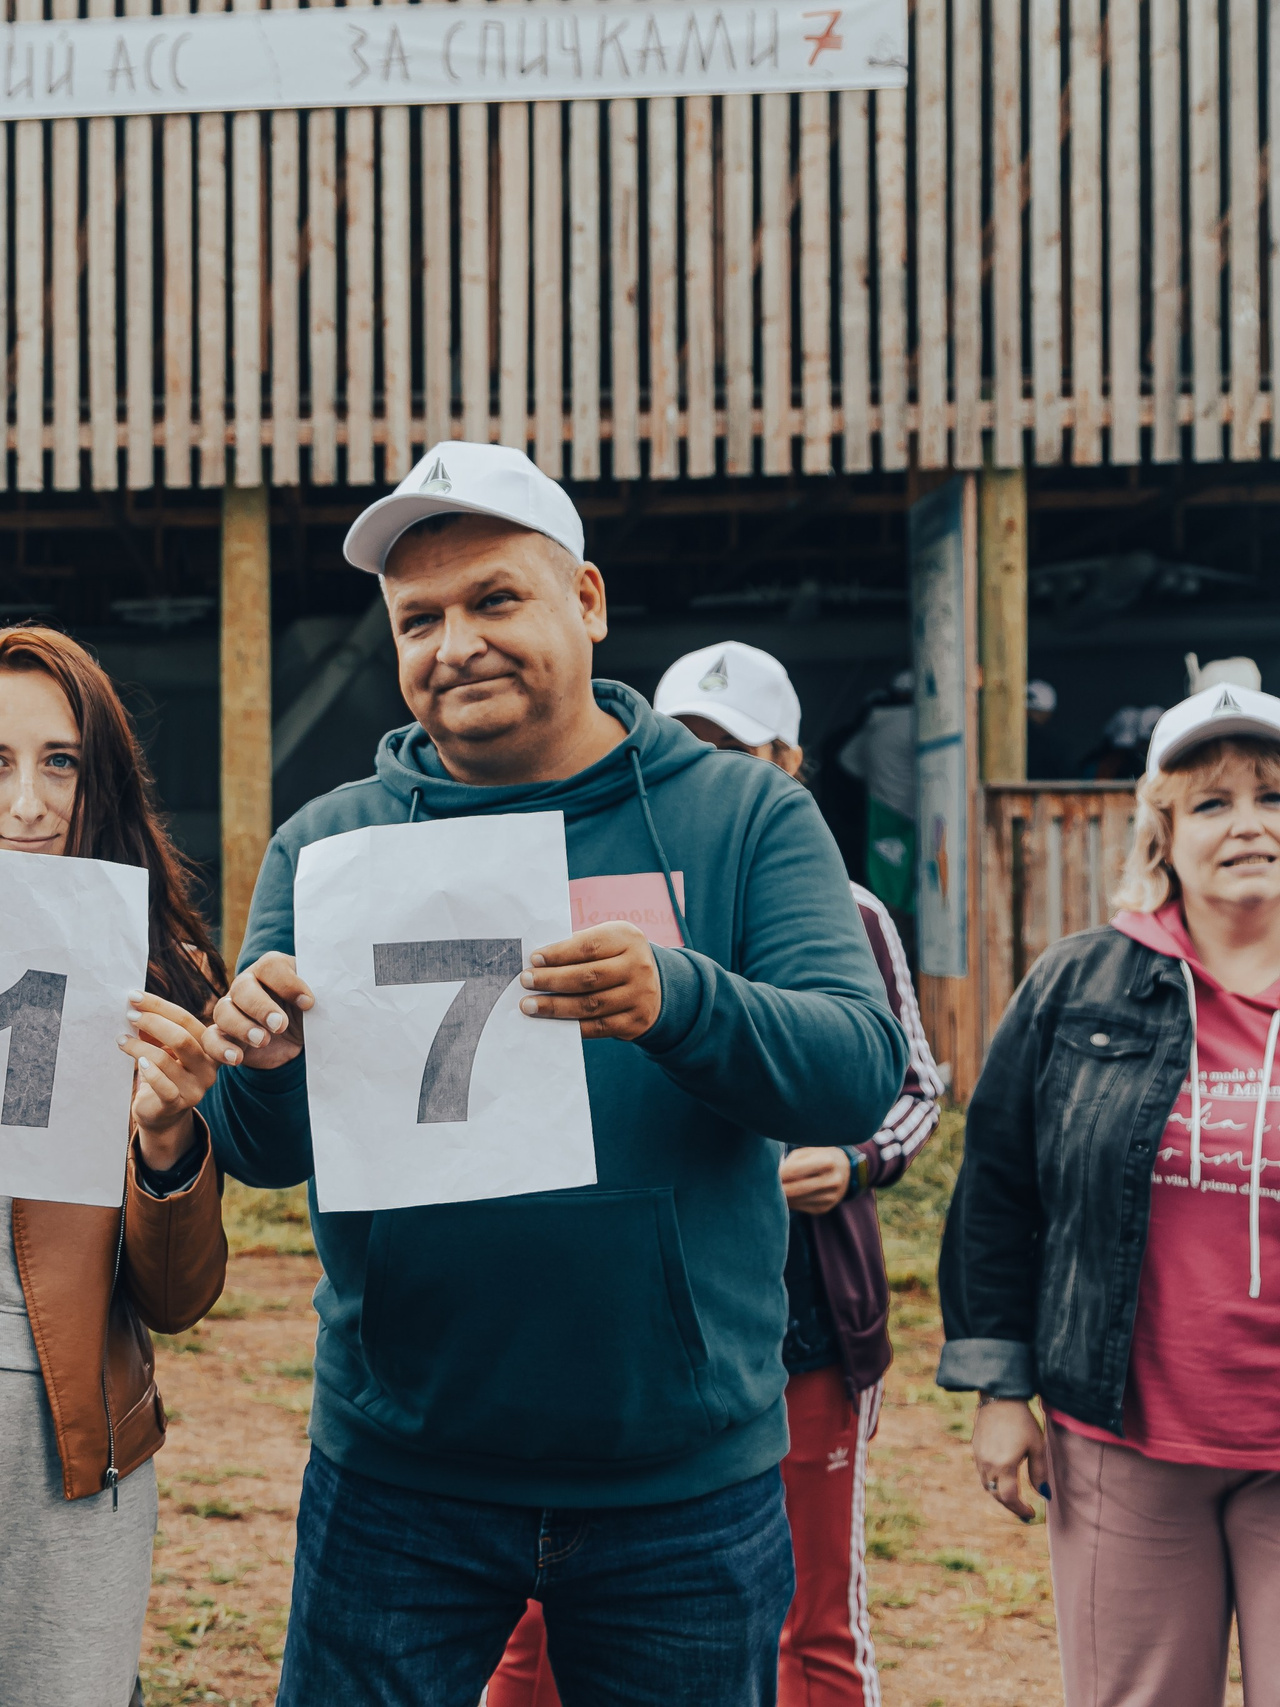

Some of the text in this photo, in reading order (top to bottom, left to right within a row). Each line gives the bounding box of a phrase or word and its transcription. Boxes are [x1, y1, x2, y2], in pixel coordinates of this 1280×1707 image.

[106, 31, 193, 94] АСС
[346, 7, 844, 89] ЗА СПИЧКАМИ 7
[372, 938, 522, 1124] 7
